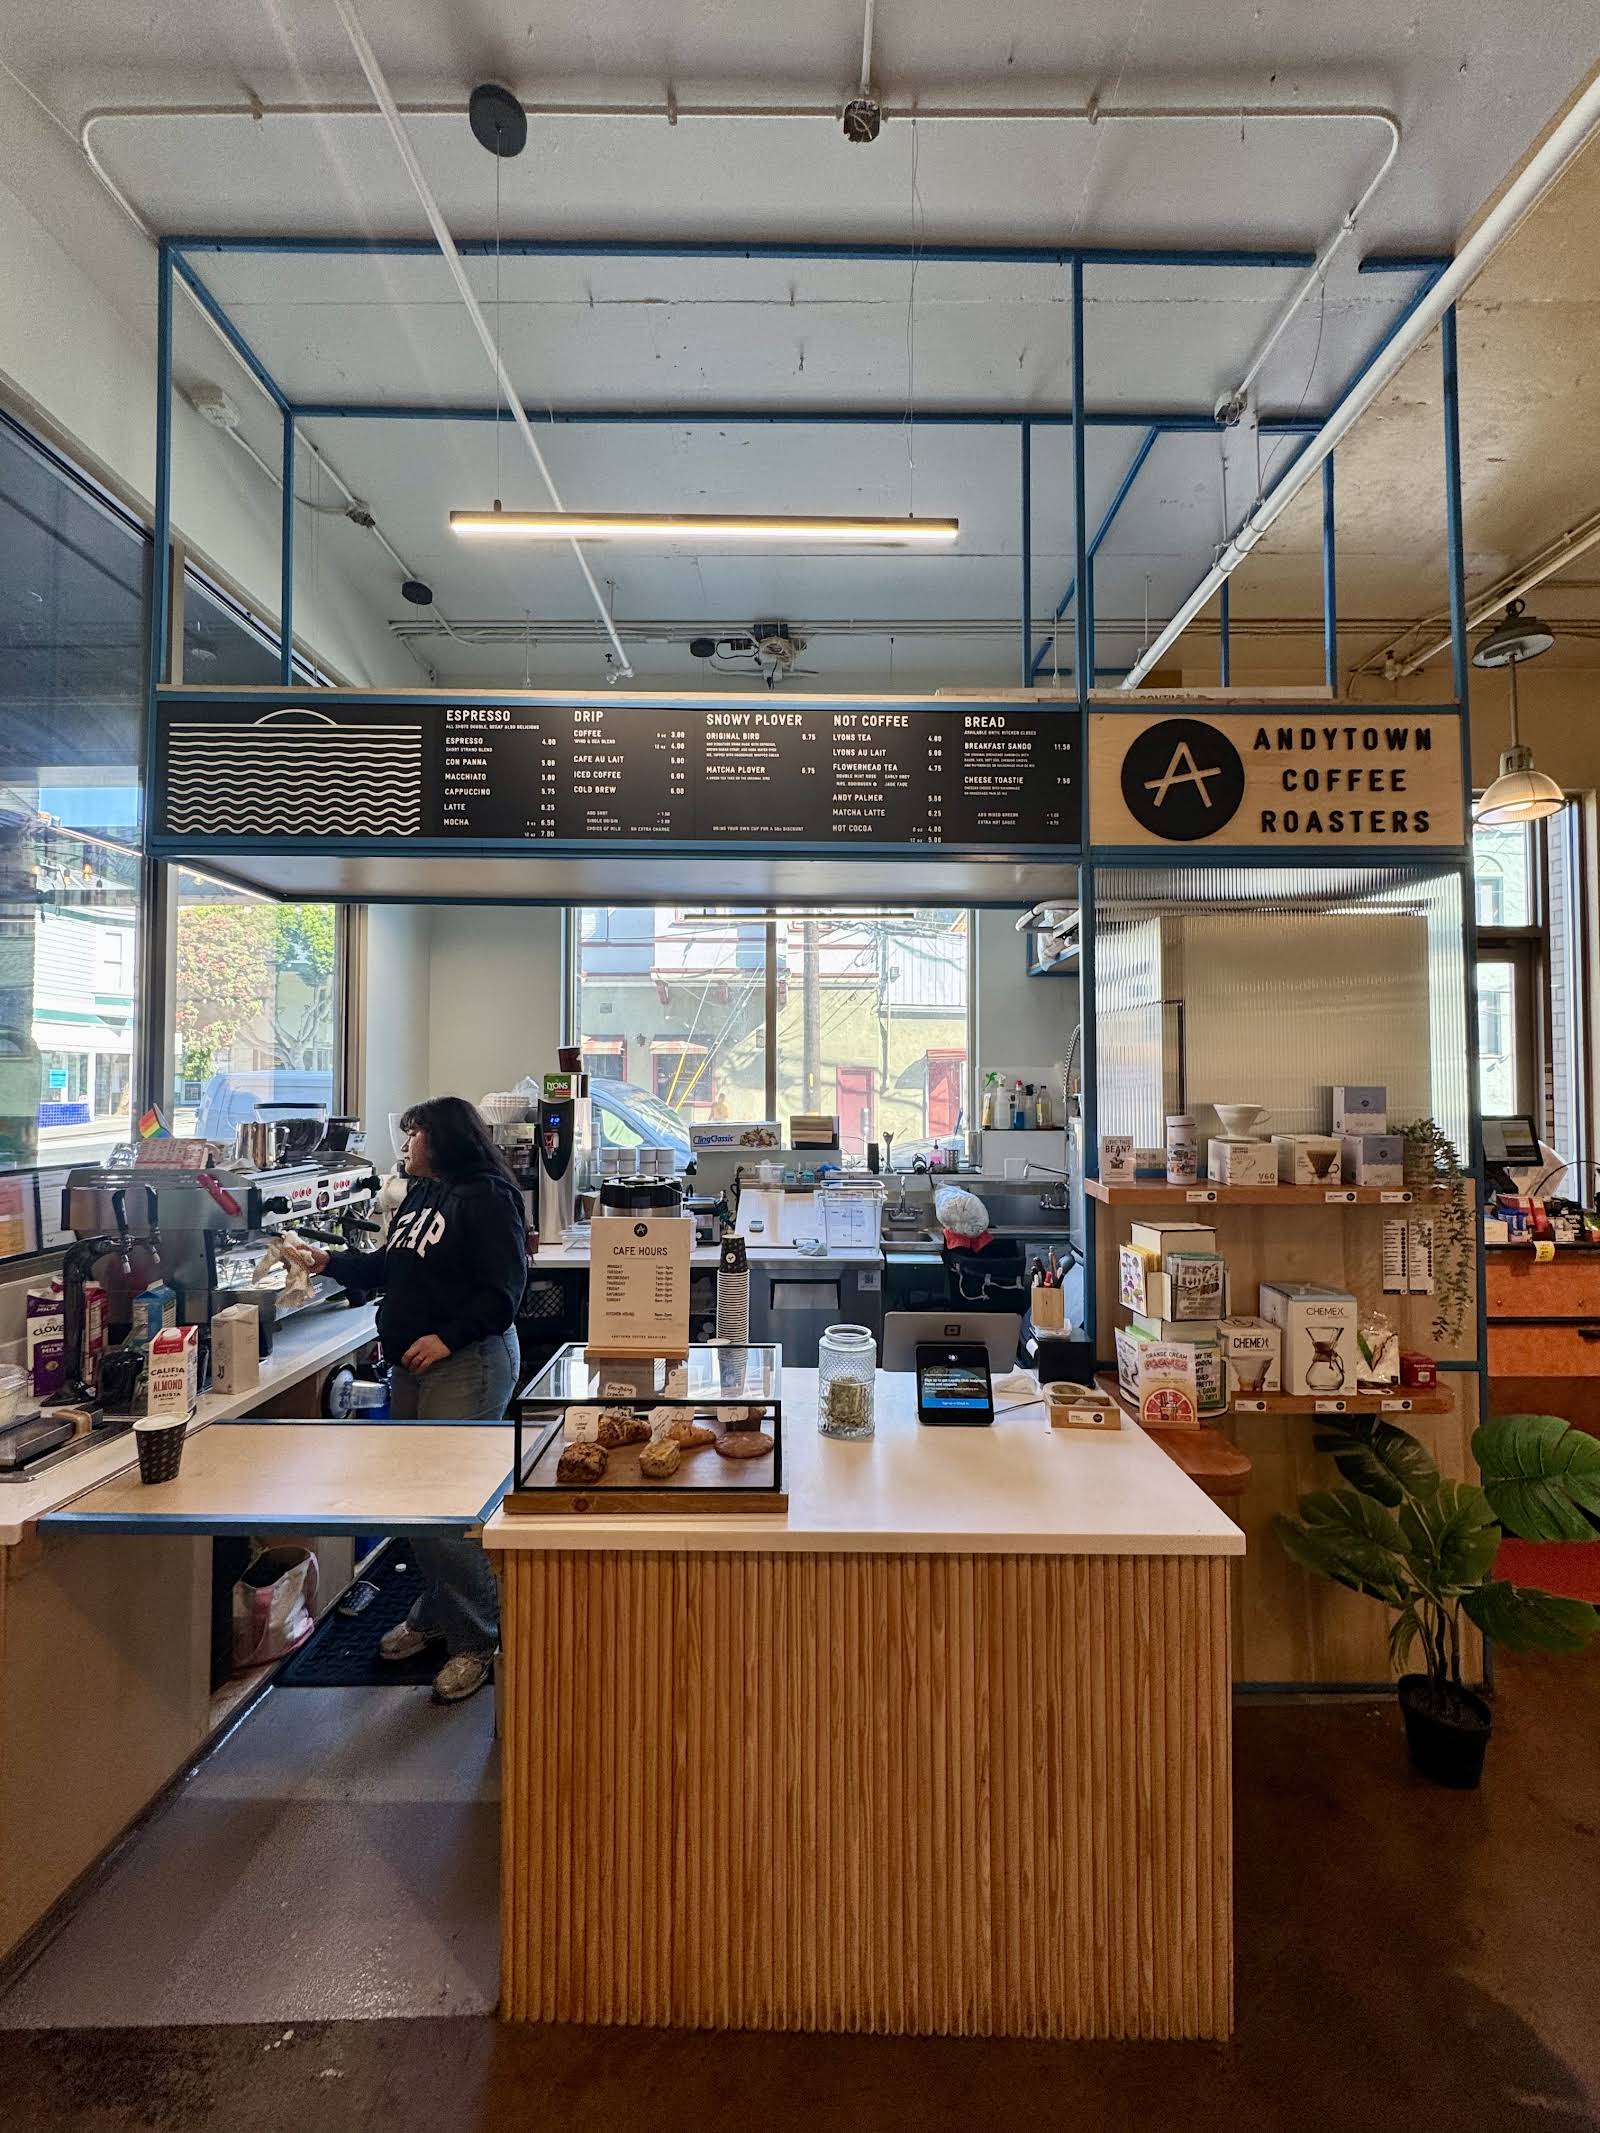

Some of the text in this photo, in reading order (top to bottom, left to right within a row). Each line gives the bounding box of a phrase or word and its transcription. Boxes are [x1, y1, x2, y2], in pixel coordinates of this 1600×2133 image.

[446, 710, 511, 722] ESPRESSO
[575, 711, 604, 722] DRIP
[707, 714, 803, 726] SNOWY PLOVER
[834, 715, 909, 727] NOT COFFEE
[964, 717, 1005, 728] BREAD
[1254, 728, 1432, 750] ANDYTOWN
[1282, 769, 1407, 792] COFFEE
[445, 788, 491, 796] CAPPUCCINO
[1262, 810, 1430, 833] ROASTERS
[547, 1082, 568, 1091] LYONS
[386, 1208, 446, 1258] GAP
[613, 1247, 668, 1256] CAFE HOURS
[1306, 1307, 1344, 1316] CHEMEX
[1234, 1338, 1269, 1349] CHEMEX
[42, 1346, 63, 1354] MILK
[1169, 1352, 1188, 1360] CREAM
[151, 1367, 185, 1376] CALIFIA
[153, 1379, 183, 1393] ALMOND
